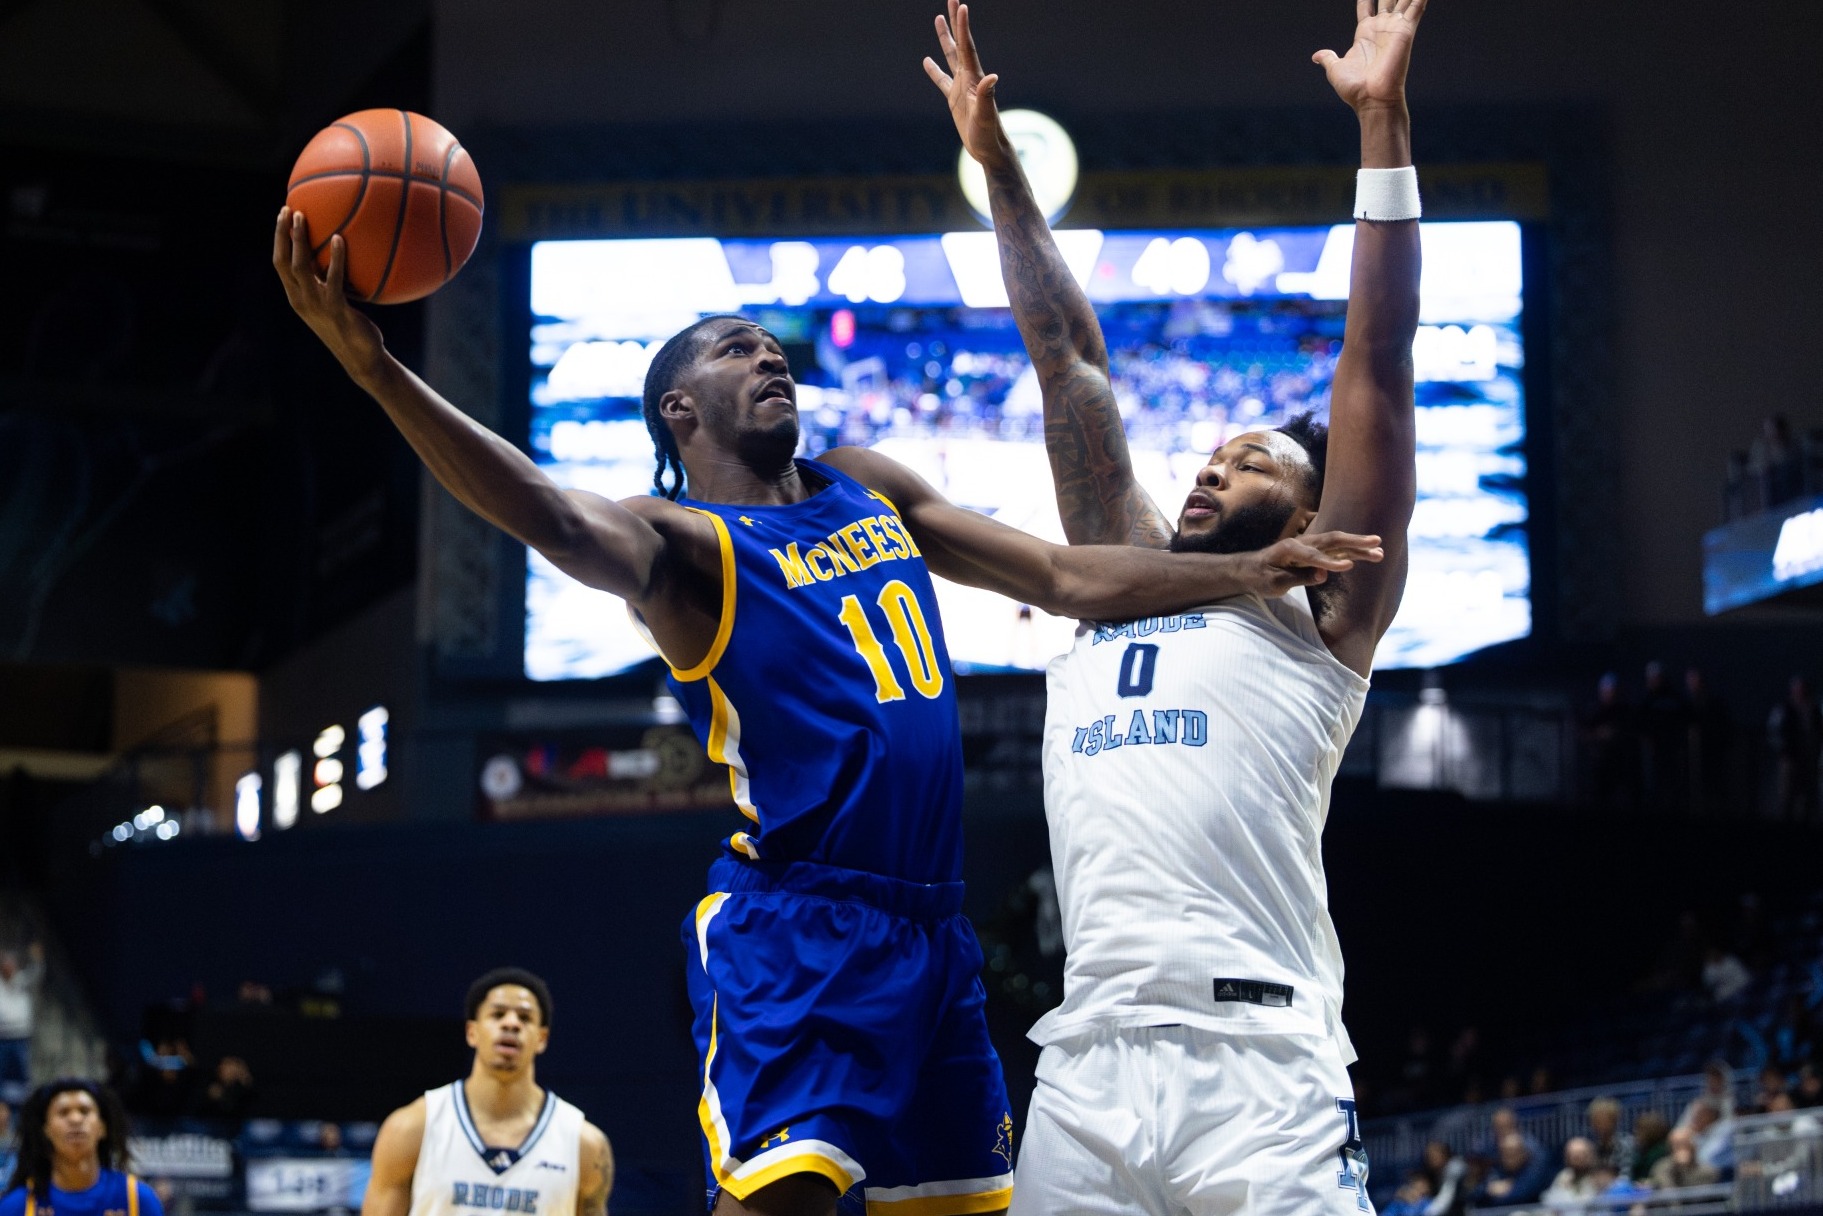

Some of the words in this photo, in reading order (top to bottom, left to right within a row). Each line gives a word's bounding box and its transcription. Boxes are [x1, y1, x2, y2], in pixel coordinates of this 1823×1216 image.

[838, 579, 944, 704] 10
[1116, 642, 1160, 700] 0
[1072, 709, 1208, 757] ISLAND
[452, 1181, 539, 1214] RHODE
